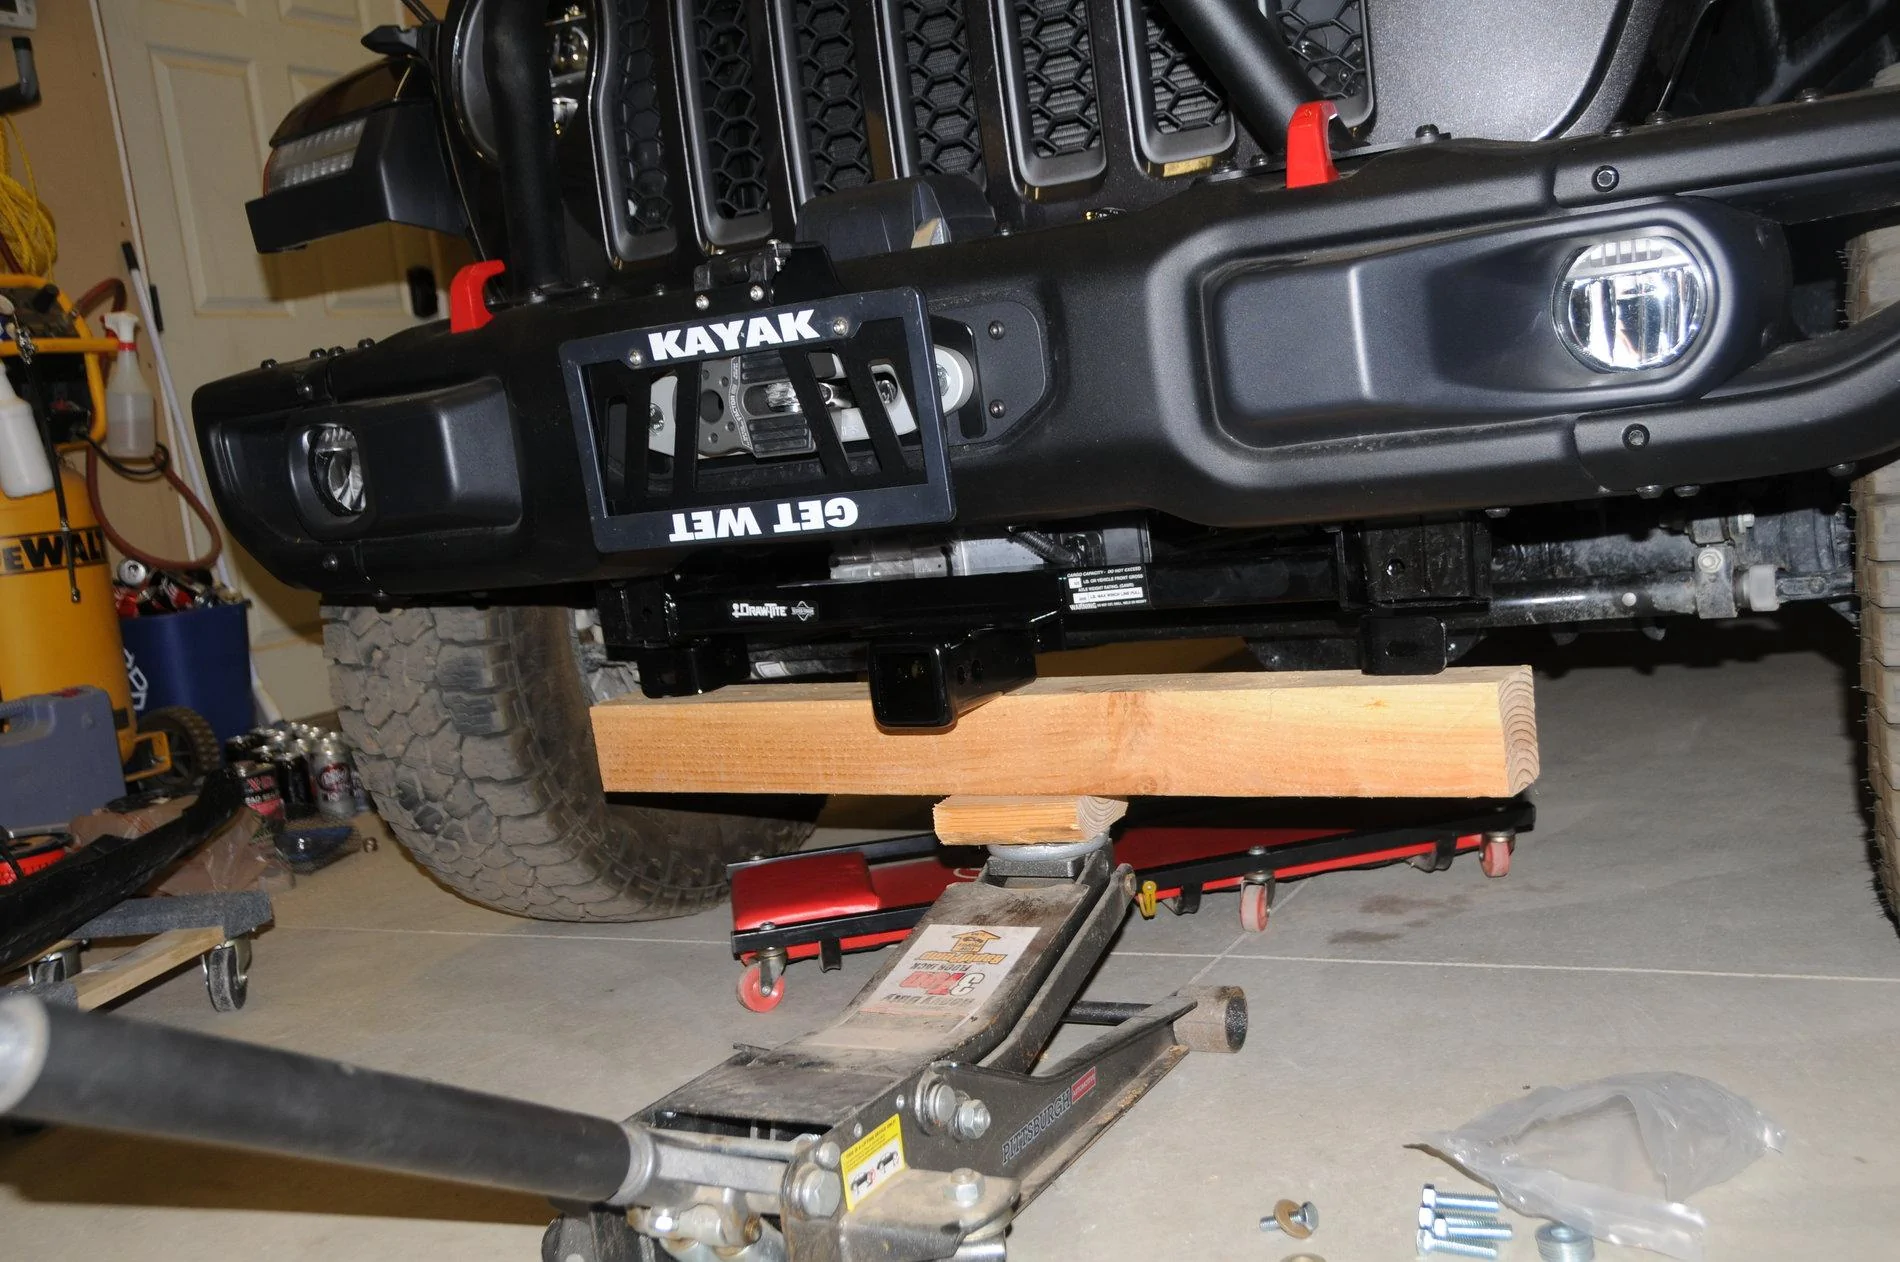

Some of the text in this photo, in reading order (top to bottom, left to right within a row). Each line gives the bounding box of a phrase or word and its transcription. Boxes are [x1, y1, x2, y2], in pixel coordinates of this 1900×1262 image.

[648, 309, 820, 361] KAYAK
[669, 497, 858, 542] GET WET
[0, 530, 104, 571] EWAL
[950, 972, 985, 996] 3
[1001, 1087, 1072, 1166] PITTSBURGH
